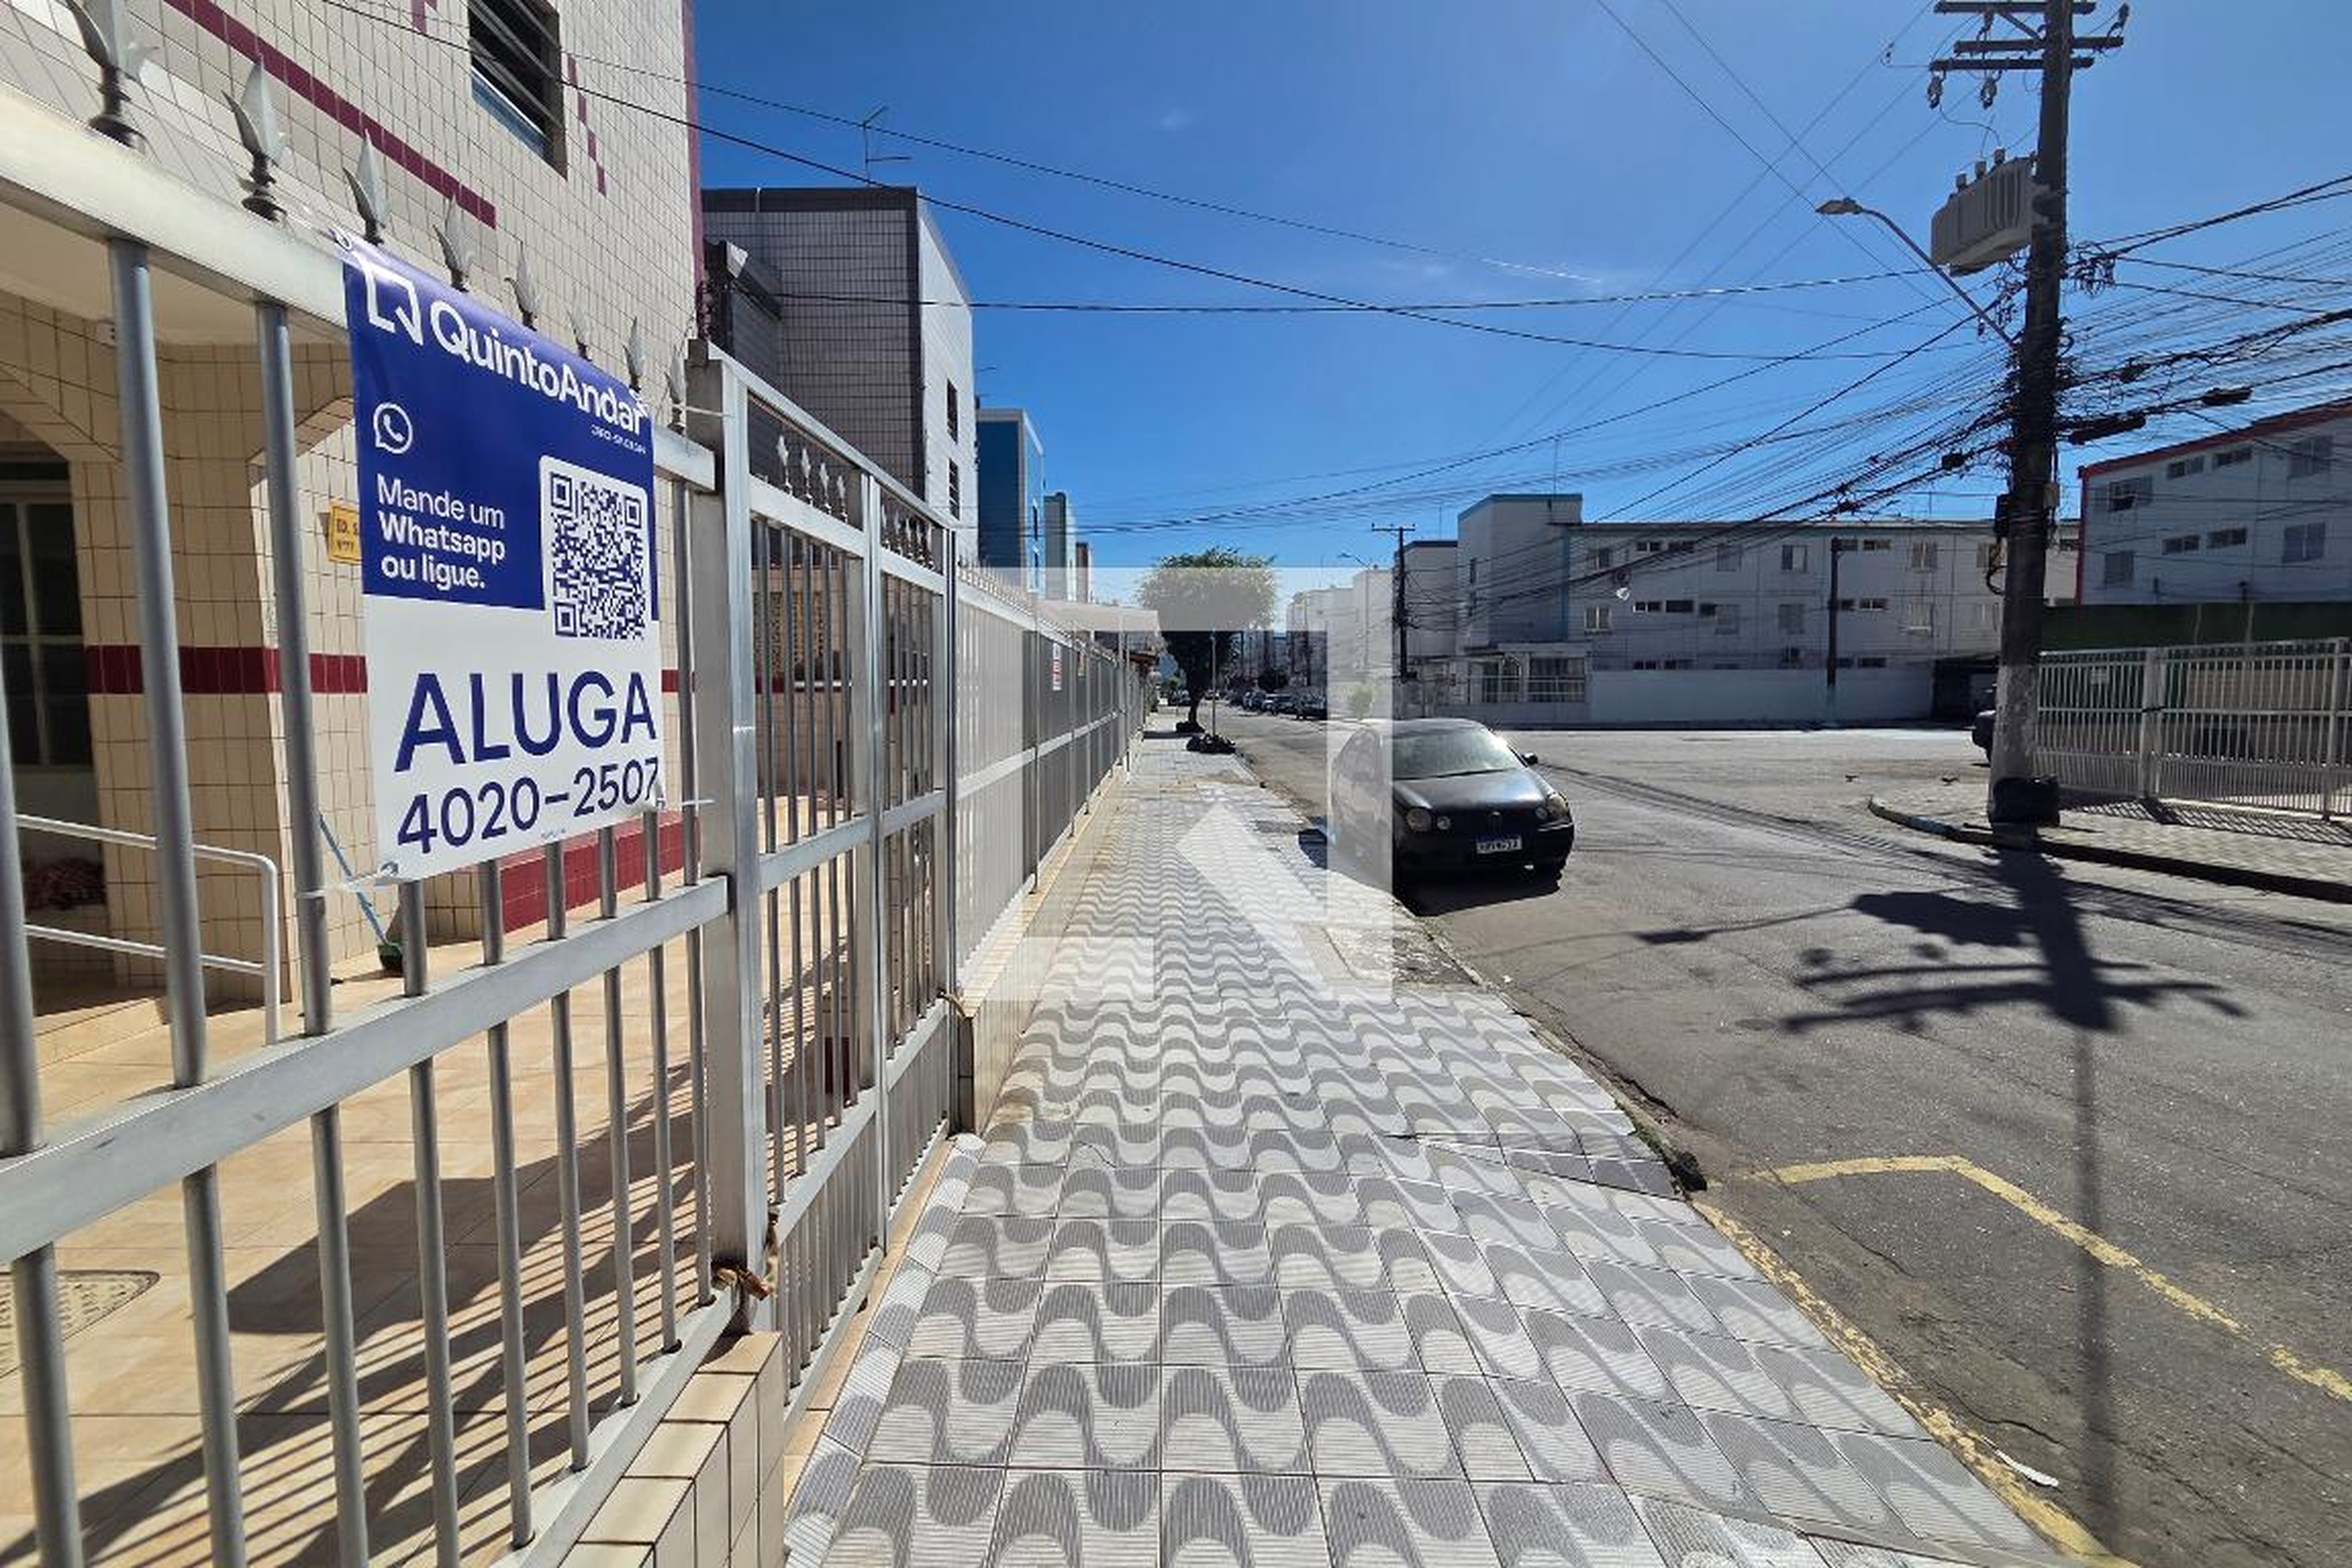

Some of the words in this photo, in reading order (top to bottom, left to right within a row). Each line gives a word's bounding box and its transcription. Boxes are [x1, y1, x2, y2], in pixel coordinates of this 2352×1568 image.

[430, 300, 647, 435] QuintoAndar
[377, 473, 464, 521] Mande
[469, 503, 505, 529] um
[377, 510, 505, 565] Whatsapp
[381, 555, 415, 581] ou
[421, 552, 486, 590] ligue.
[394, 671, 657, 772] ALUGA
[397, 756, 658, 854] 4020-2507
